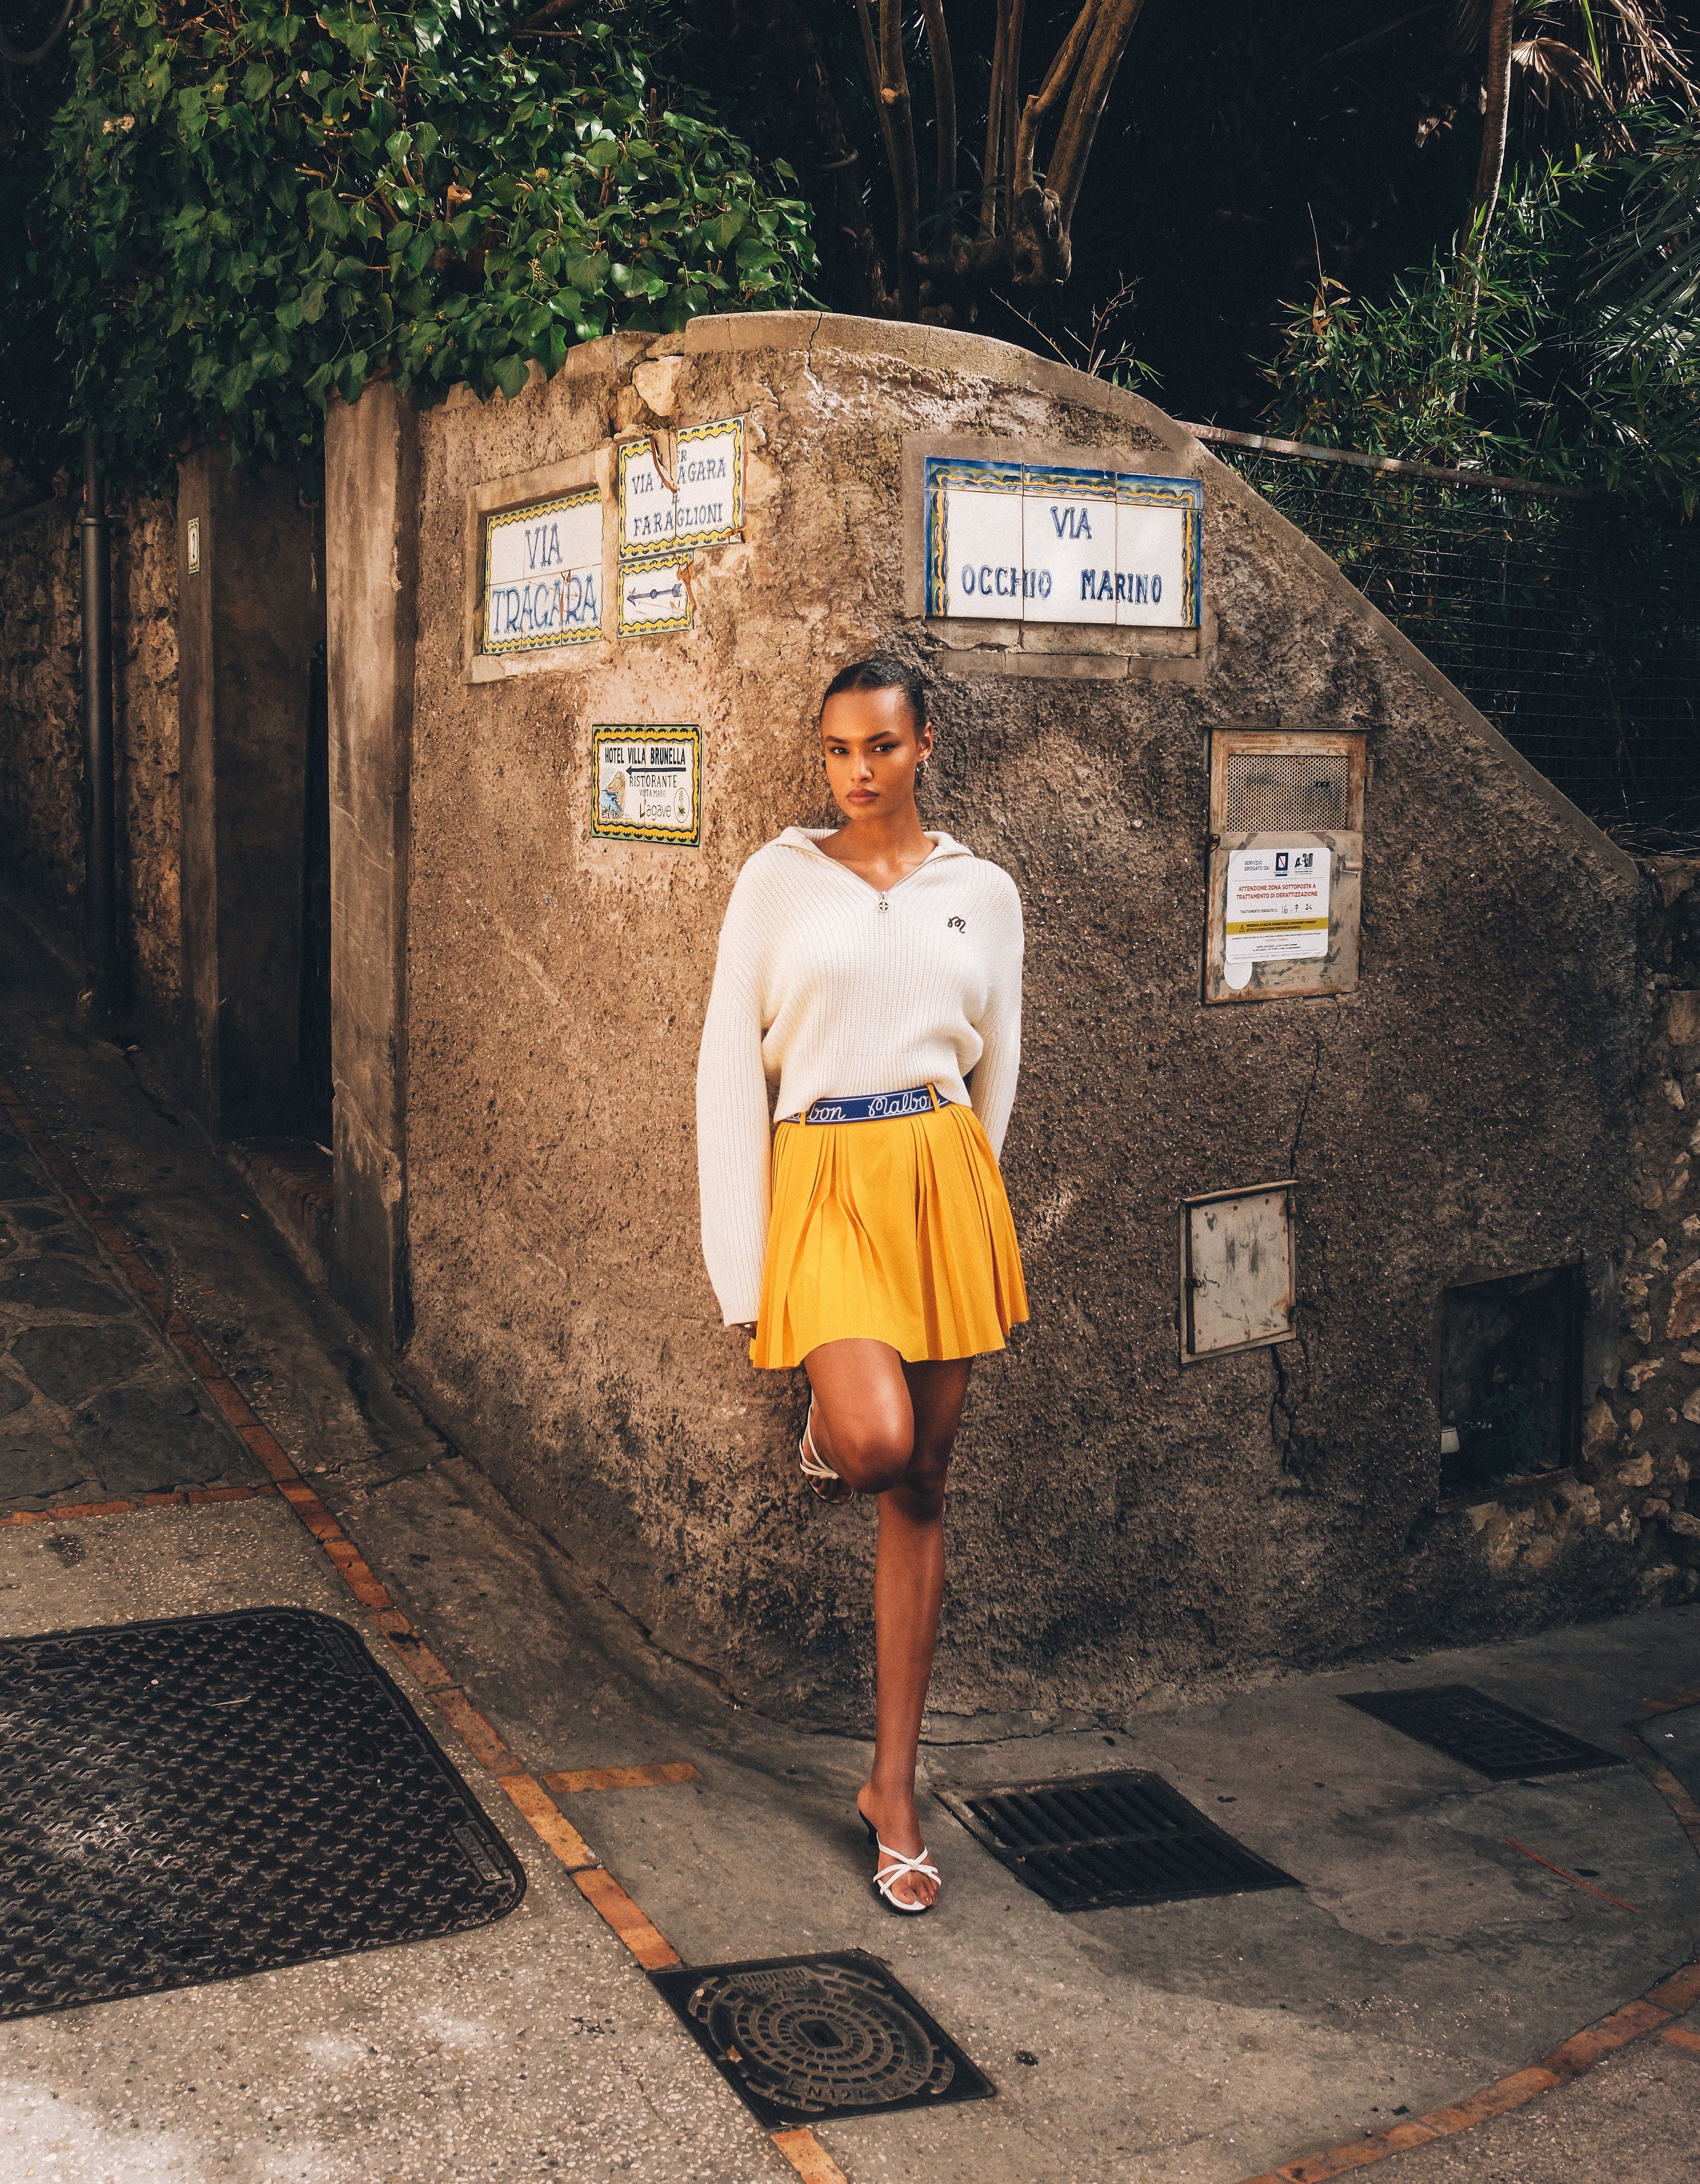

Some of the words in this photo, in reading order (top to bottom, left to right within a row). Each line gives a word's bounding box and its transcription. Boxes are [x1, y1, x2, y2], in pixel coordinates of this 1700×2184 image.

[631, 471, 654, 495] VIA
[657, 456, 727, 490] AGARA
[633, 502, 723, 537] FARAGLIONI
[1050, 506, 1092, 540] VIA
[525, 522, 563, 570] VIA
[960, 564, 1053, 599] OCCHIO
[1080, 568, 1162, 605] MARINO
[491, 573, 599, 635] TRAGARA
[605, 747, 624, 764] HOTEL
[627, 747, 646, 764] VILLA
[650, 747, 686, 765] BRUNELLA
[629, 774, 678, 788] RISTORANTE
[639, 789, 652, 797] VISTA
[653, 789, 667, 798] MARE
